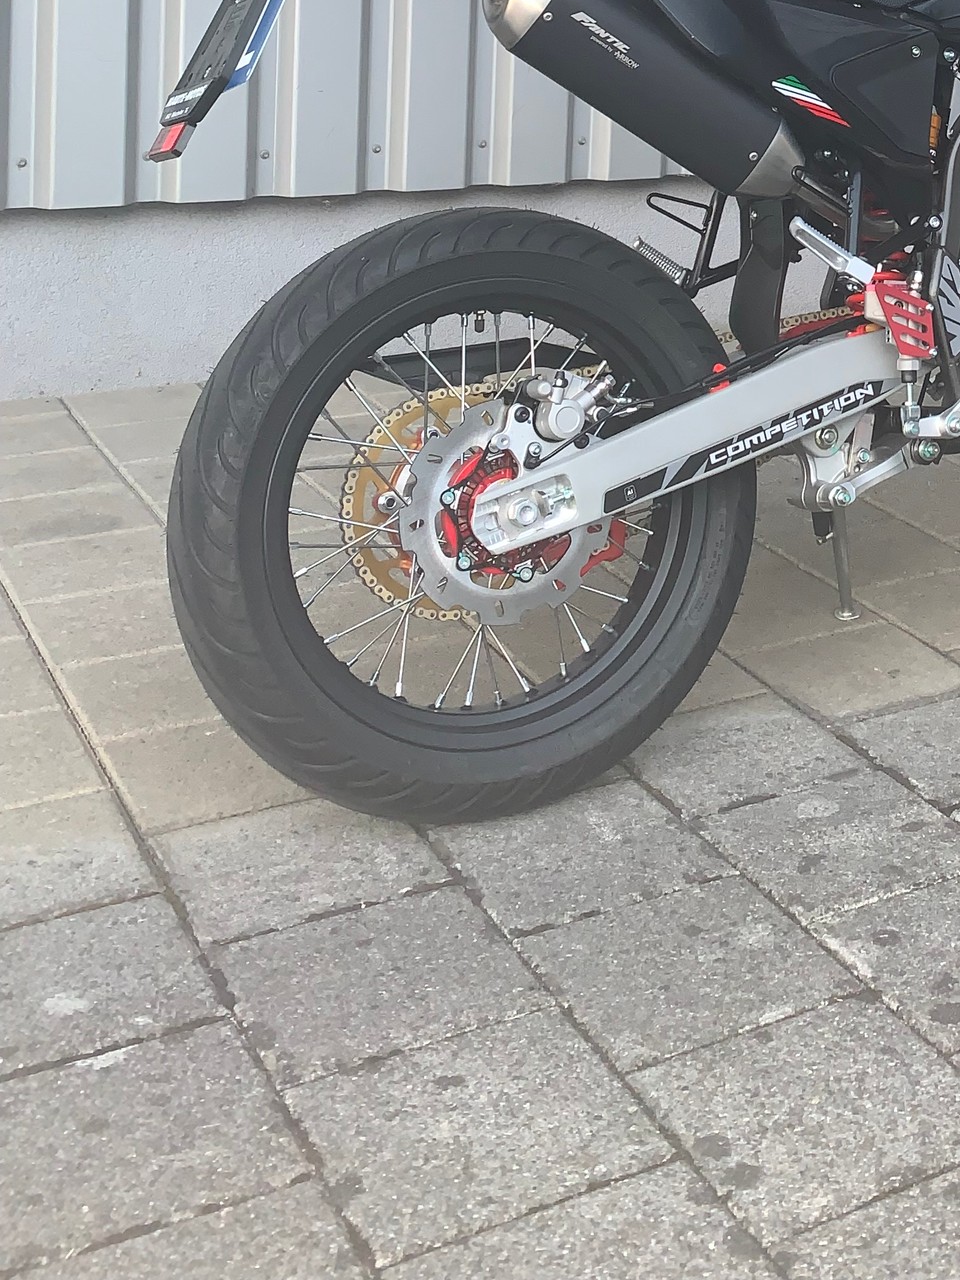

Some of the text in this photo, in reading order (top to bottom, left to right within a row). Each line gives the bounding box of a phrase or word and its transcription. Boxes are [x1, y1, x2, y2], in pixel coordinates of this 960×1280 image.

[570, 11, 631, 53] FANTIC
[613, 50, 640, 69] ARROW
[709, 383, 875, 465] COMPETITION
